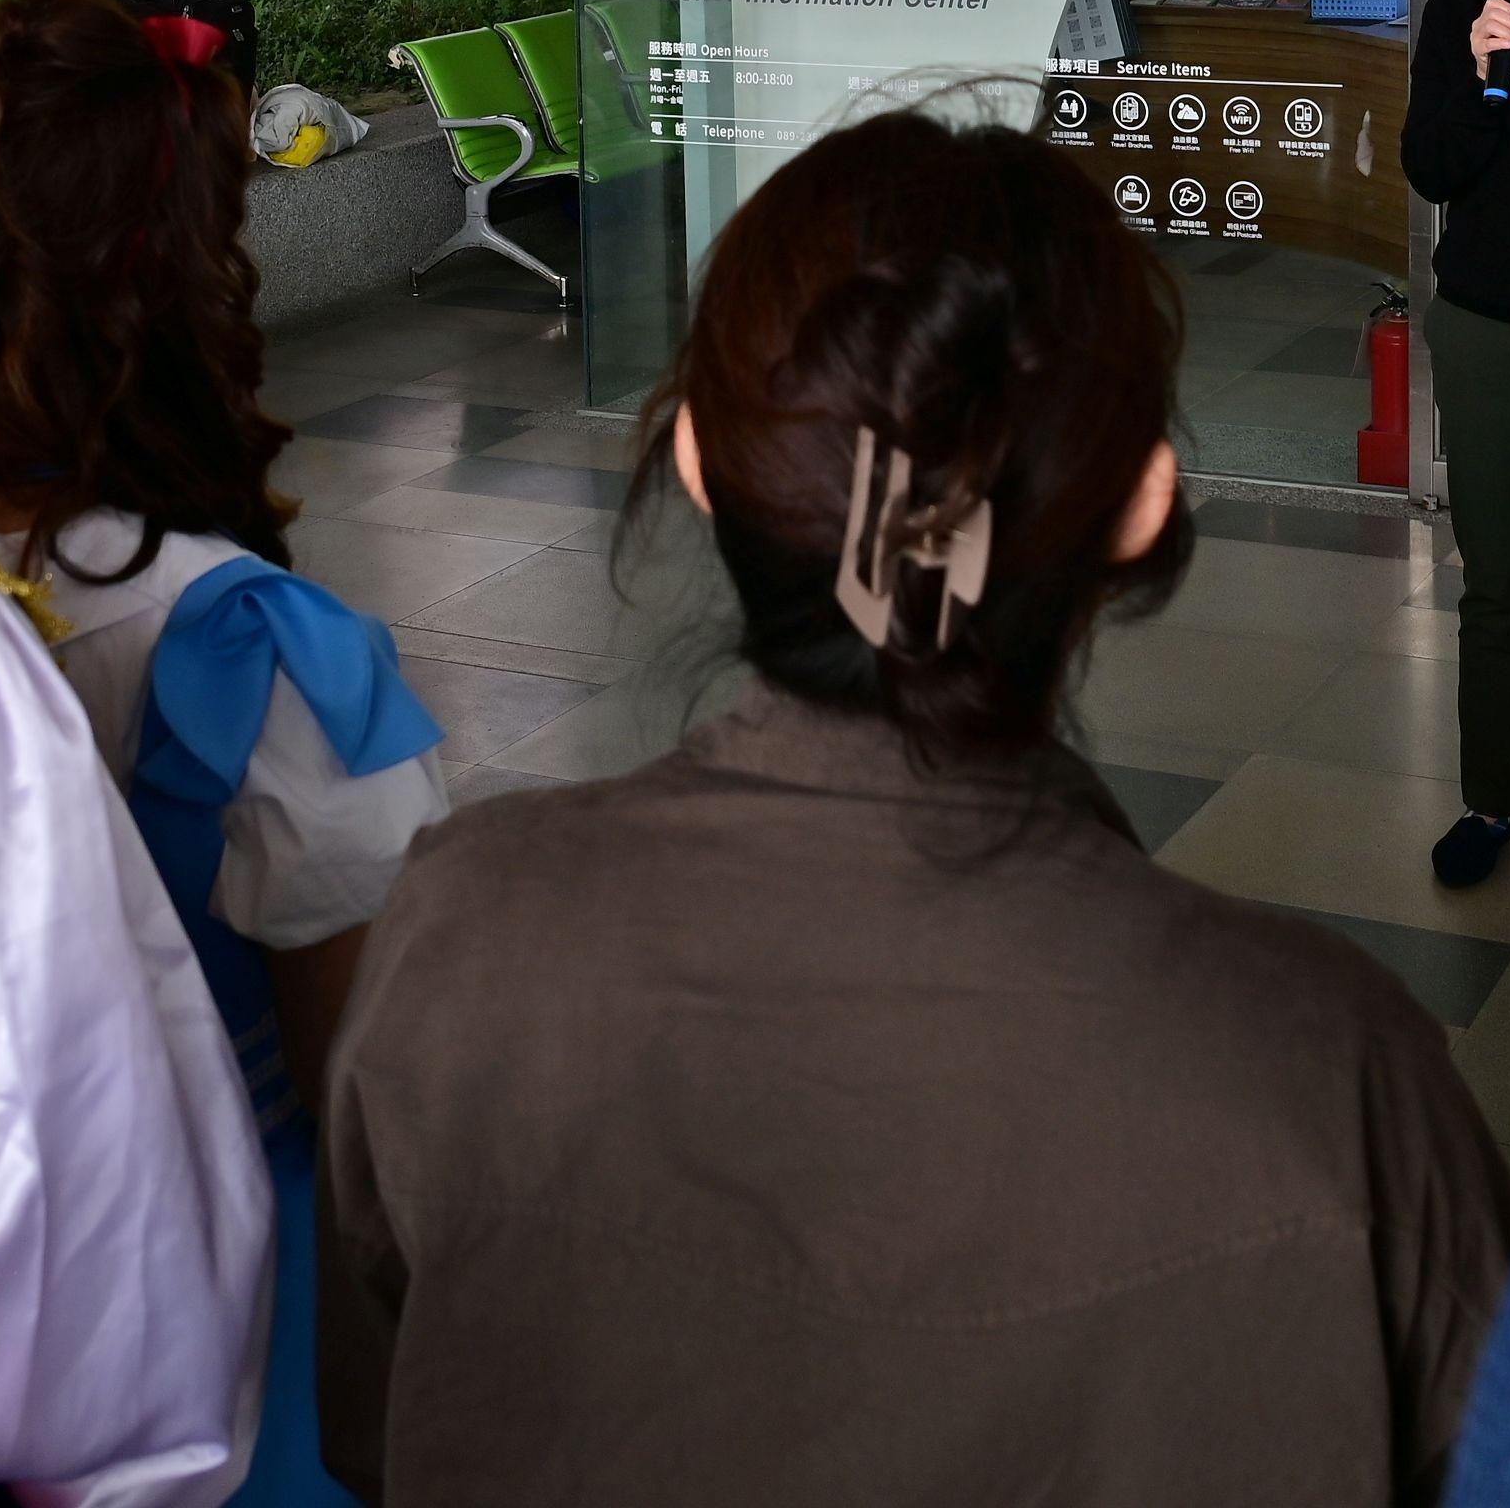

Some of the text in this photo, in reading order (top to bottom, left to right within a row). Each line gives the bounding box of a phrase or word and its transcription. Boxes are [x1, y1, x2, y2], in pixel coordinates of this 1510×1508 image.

[648, 41, 769, 59] 服務時間 Open Hours
[1045, 57, 1211, 77] 服務項目 Service Items
[649, 67, 794, 86] 週一至週五 8:00-18:00
[1230, 115, 1253, 125] WIFI
[701, 124, 766, 140] Telephone
[1065, 139, 1095, 147] Information
[1110, 141, 1154, 150] Travel Brochures
[1171, 143, 1201, 152] Attractions
[1228, 146, 1242, 154] Free
[1286, 149, 1325, 159] Free Charging
[1166, 227, 1189, 236] Reading
[1222, 230, 1263, 240] Send Postcards
